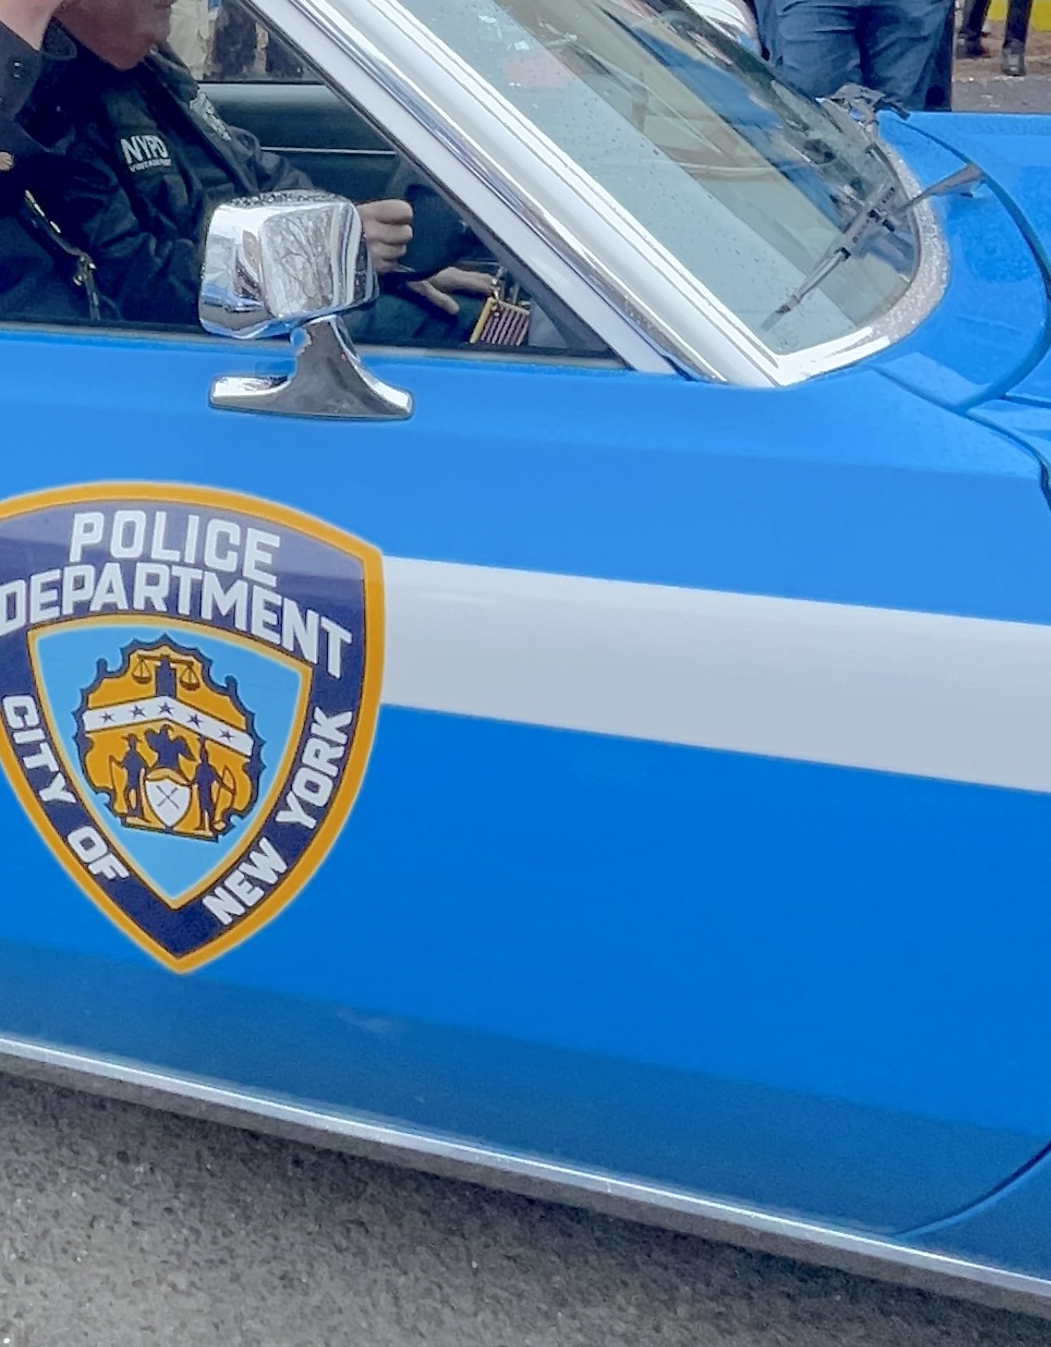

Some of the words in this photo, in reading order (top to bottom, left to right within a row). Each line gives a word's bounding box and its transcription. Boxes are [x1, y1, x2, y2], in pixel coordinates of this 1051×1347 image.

[120, 135, 169, 164] NYPD
[69, 510, 281, 588] POLICE
[3, 695, 76, 805] CITY
[66, 825, 130, 881] OF
[202, 837, 288, 926] NEW
[276, 707, 352, 830] YORK
